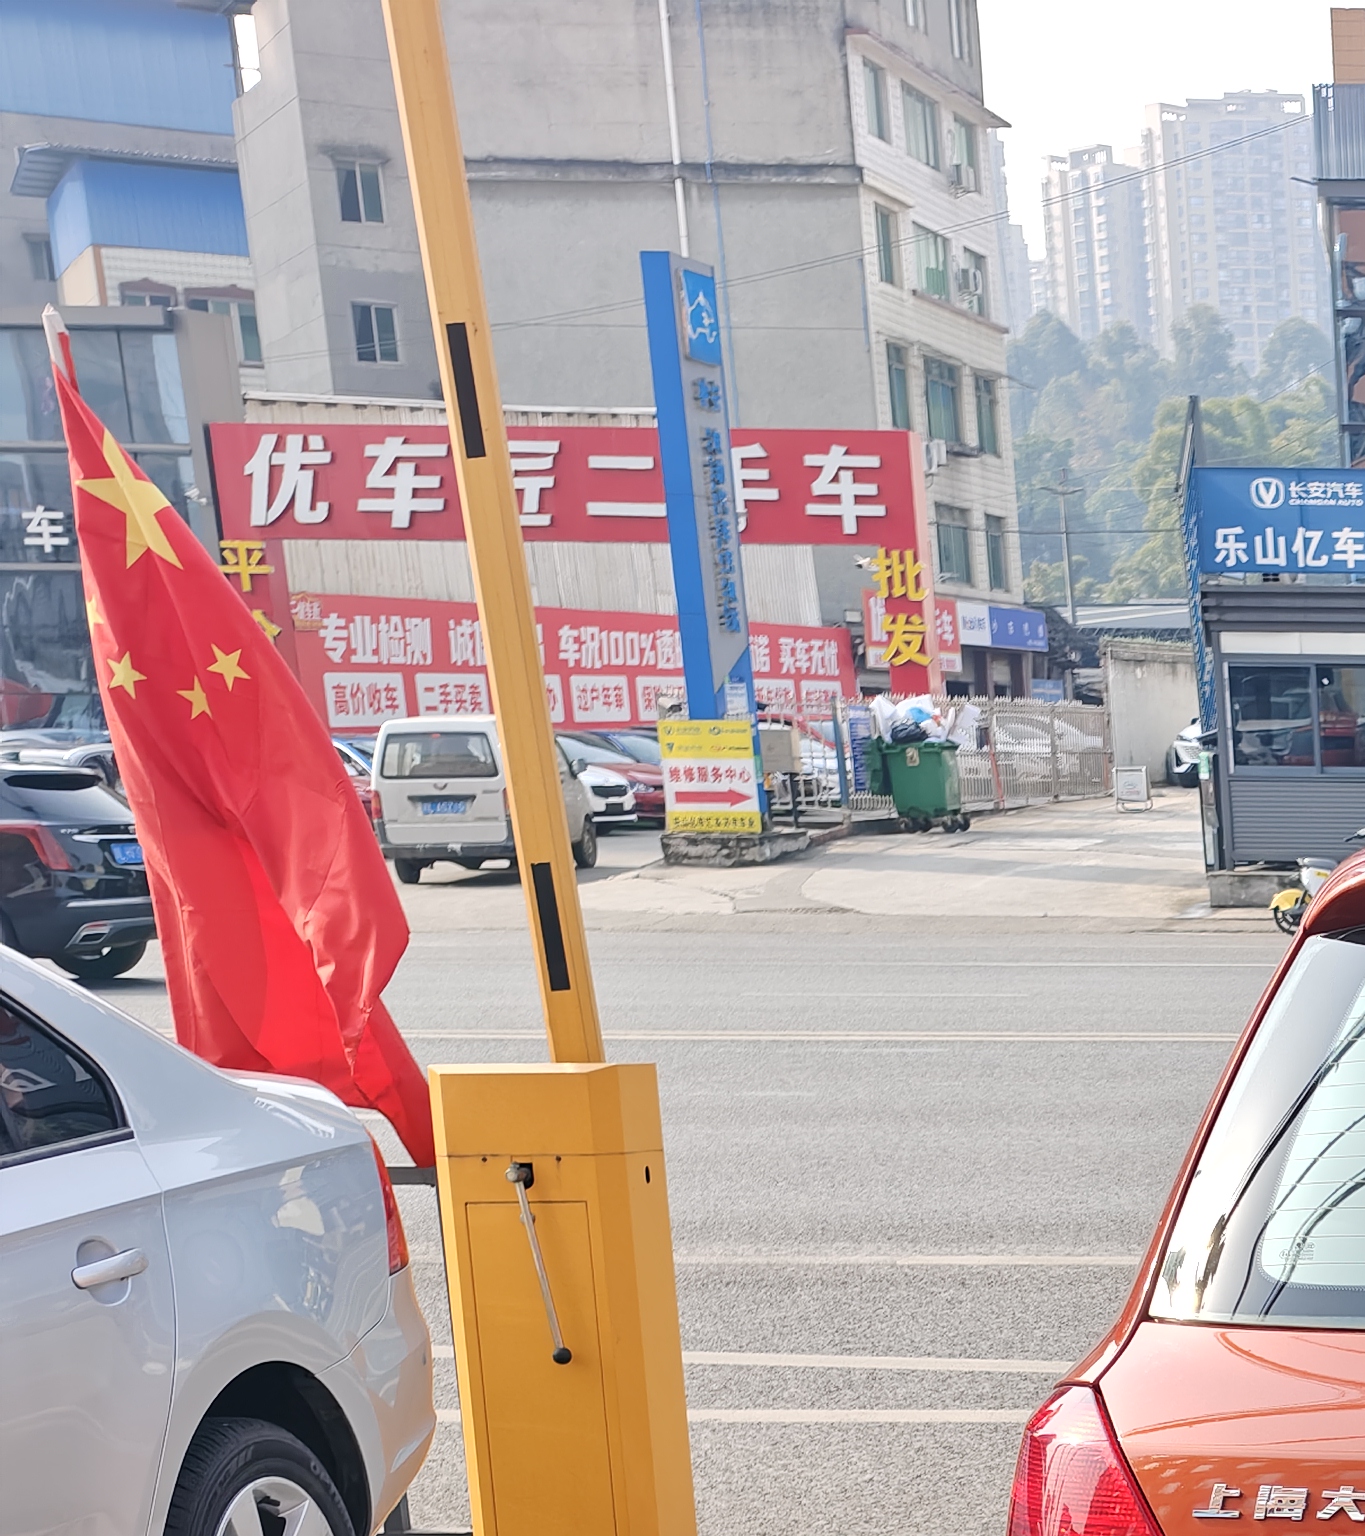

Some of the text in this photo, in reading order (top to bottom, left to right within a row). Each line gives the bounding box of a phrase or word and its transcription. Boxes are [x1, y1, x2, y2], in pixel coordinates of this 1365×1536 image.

[1288, 481, 1364, 499] 长安汽车
[22, 505, 70, 553] 车
[871, 546, 933, 667] 批发
[319, 613, 433, 665] 专业检测
[331, 682, 400, 716] 高价收车
[668, 766, 752, 784] 维修服务中心
